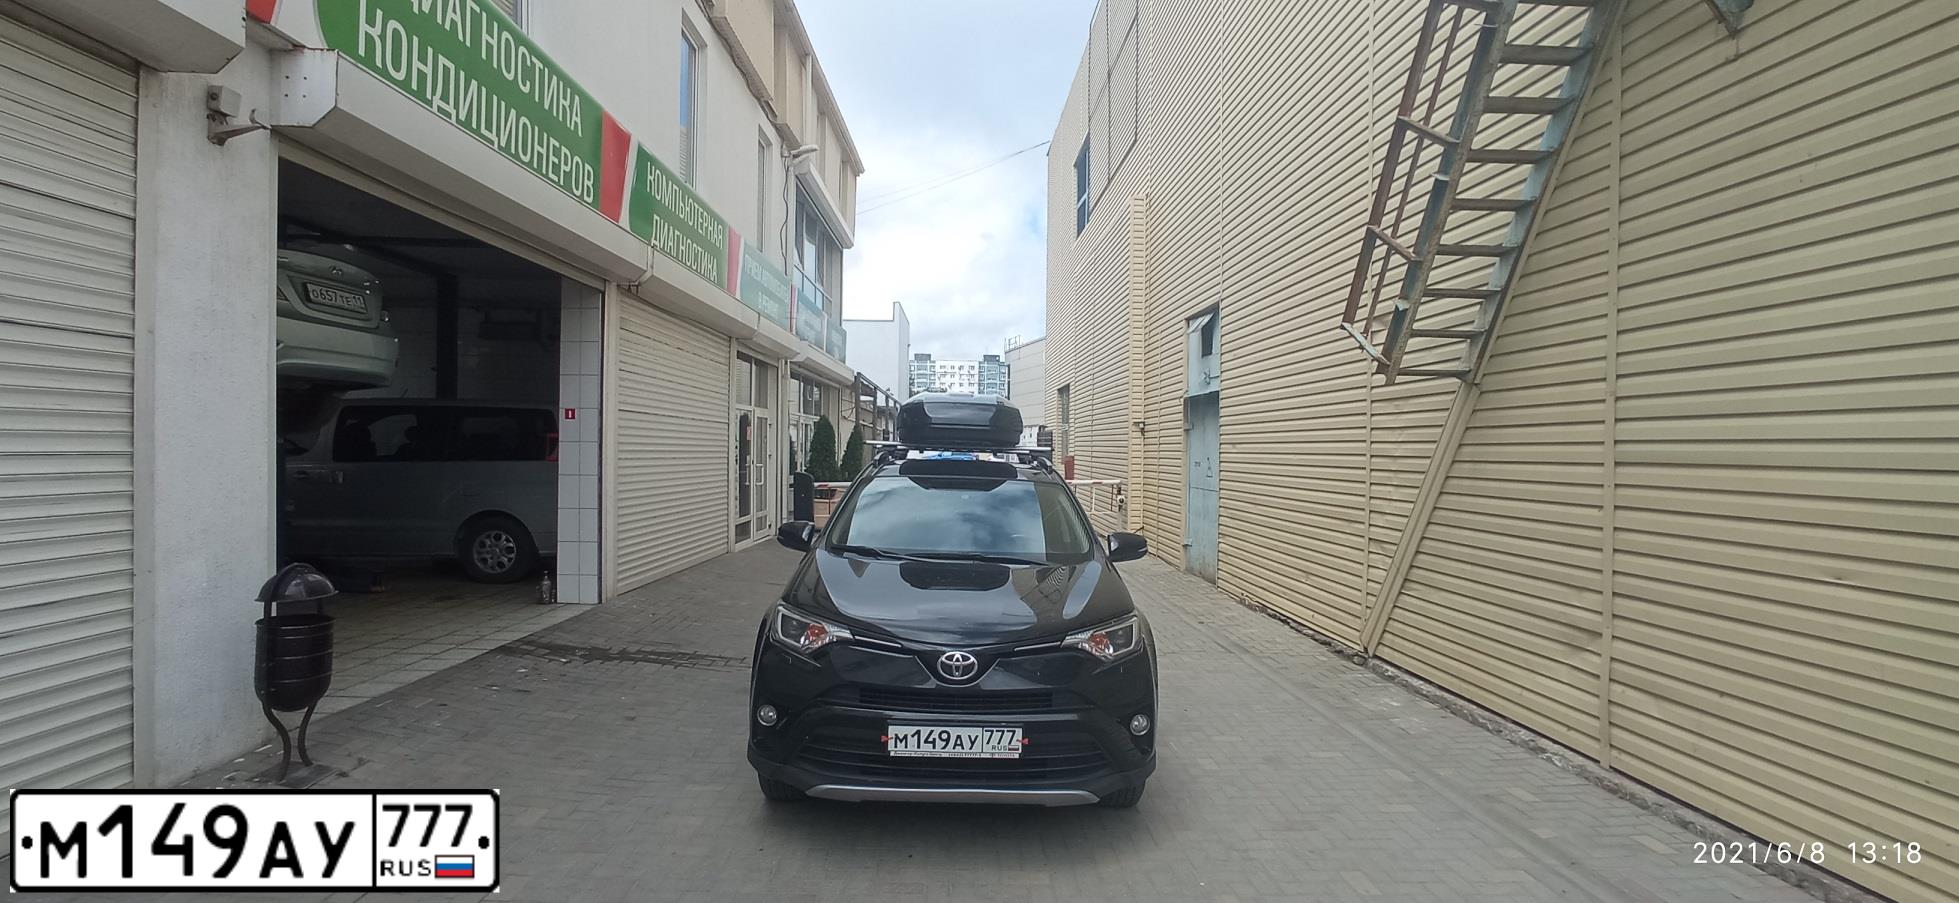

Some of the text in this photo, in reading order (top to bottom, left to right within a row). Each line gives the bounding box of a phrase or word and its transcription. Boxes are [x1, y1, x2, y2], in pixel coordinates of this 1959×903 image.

[358, 0, 594, 203] КОНДИЦИОНЕРОВ
[411, 0, 583, 137] АГНОСТИКА
[646, 161, 723, 249] КОМПЬЮТЕРНАЯ
[651, 214, 718, 283] ДИАГНОСТИКА
[893, 729, 1017, 750] М149АУ 777
